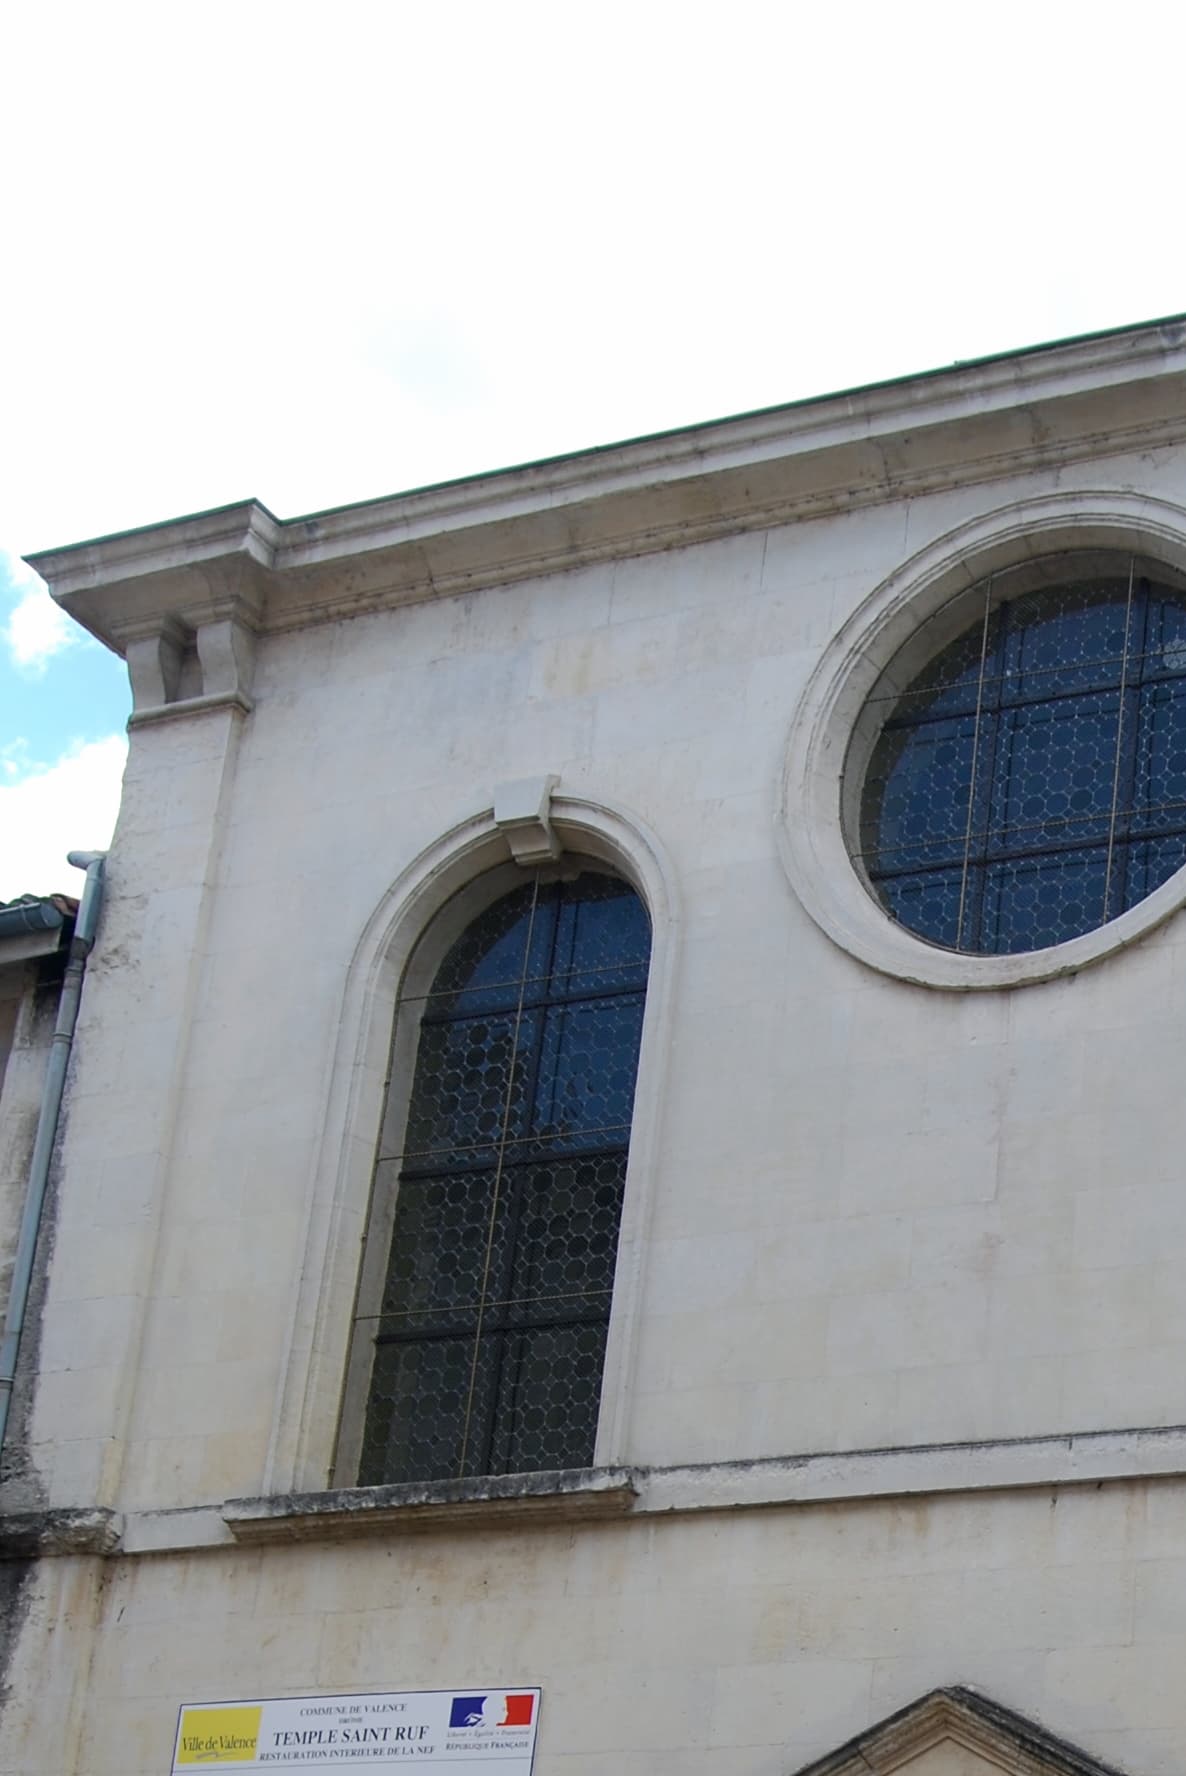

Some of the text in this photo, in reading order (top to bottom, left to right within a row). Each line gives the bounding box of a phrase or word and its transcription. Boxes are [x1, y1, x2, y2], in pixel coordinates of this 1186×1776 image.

[300, 1703, 407, 1717] COMMUNE DE VALENCE
[183, 1733, 257, 1752] Ville de Valence
[273, 1725, 430, 1746] TEMPLE SAINT RUF
[259, 1749, 327, 1761] RESTAURATION
[387, 1747, 399, 1757] DE
[402, 1746, 414, 1756] LA
[417, 1745, 436, 1755] NEF
